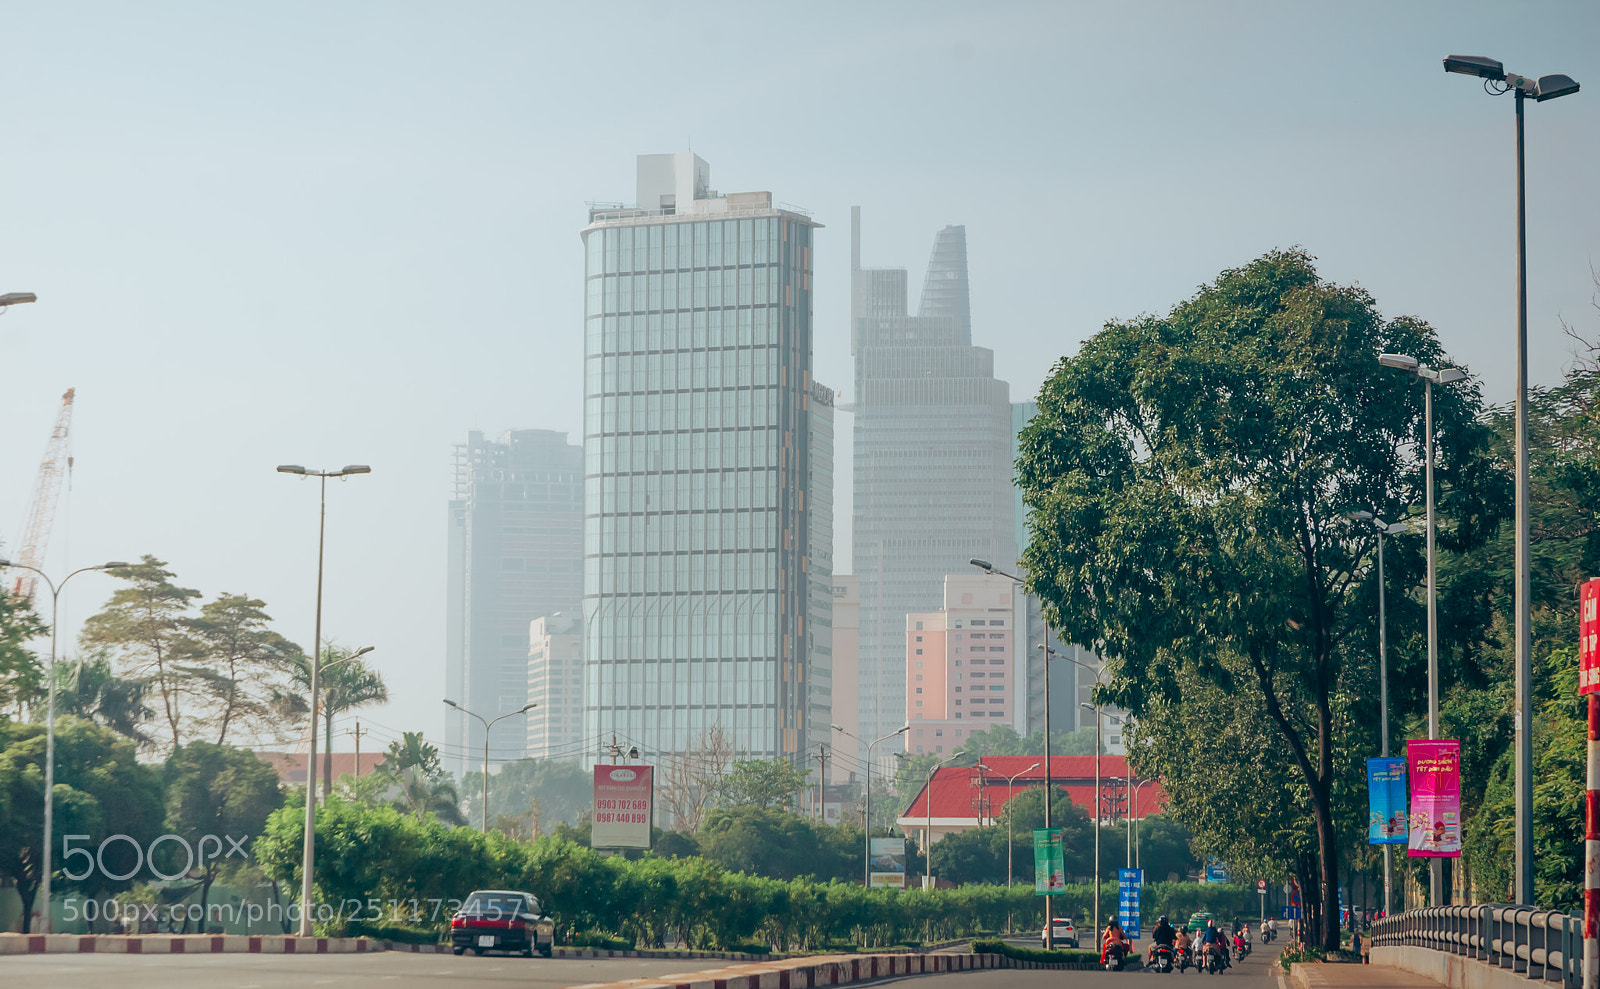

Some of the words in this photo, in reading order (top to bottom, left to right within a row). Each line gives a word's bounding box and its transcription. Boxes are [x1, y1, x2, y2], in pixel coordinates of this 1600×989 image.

[1584, 588, 1597, 623] CẤM
[597, 800, 616, 810] 0903
[618, 800, 630, 810] 702
[632, 800, 646, 810] 689
[596, 812, 614, 823] 0987
[616, 813, 630, 823] 440
[632, 814, 646, 824] 899
